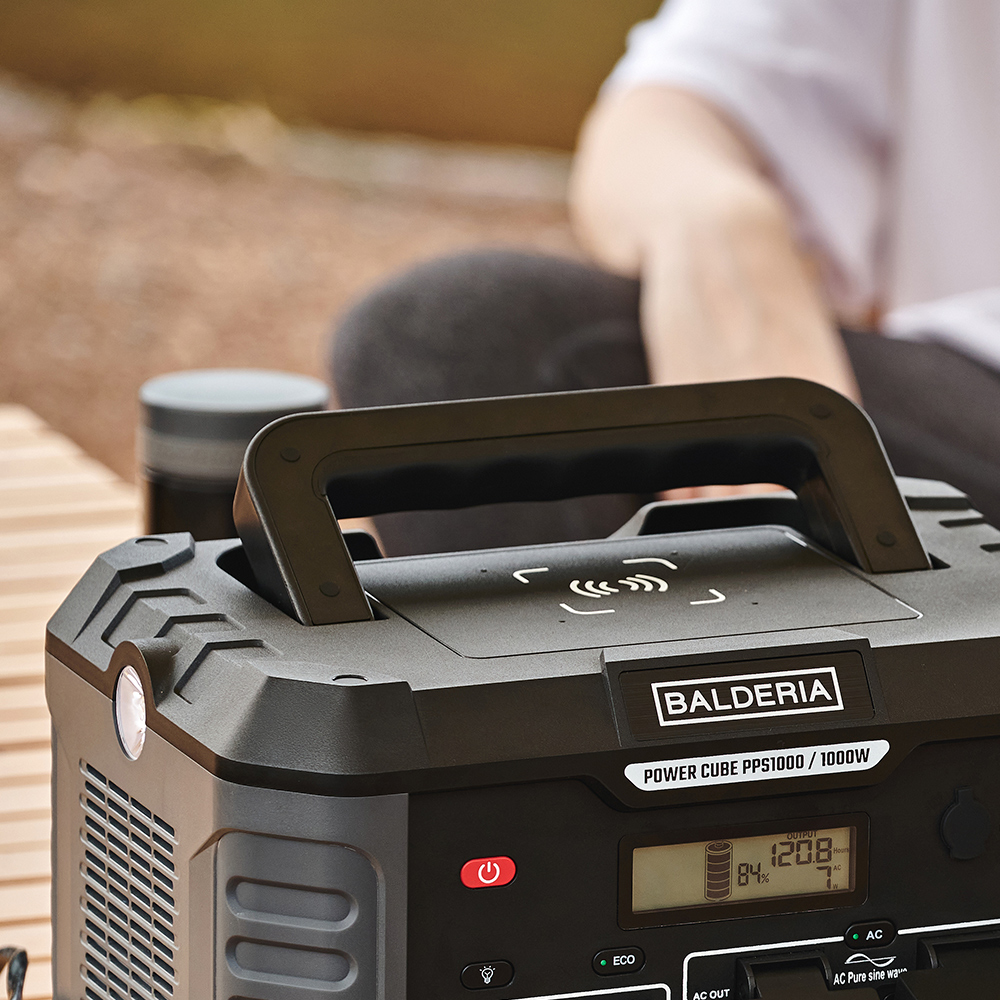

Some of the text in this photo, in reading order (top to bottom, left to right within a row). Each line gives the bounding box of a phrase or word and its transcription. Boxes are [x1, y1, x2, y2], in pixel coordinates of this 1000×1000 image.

[663, 678, 833, 716] BALDERIA
[643, 748, 871, 784] POWER CUBE PPS1000 / 1000W
[786, 830, 818, 840] OUTPUT
[771, 837, 832, 868] 120.8
[816, 865, 832, 890] 7
[865, 929, 884, 941] AC
[612, 954, 636, 967] ECO
[833, 971, 847, 986] AC
[847, 970, 868, 984] Pure
[867, 968, 886, 982] sine
[692, 988, 731, 1000] AC OUT
